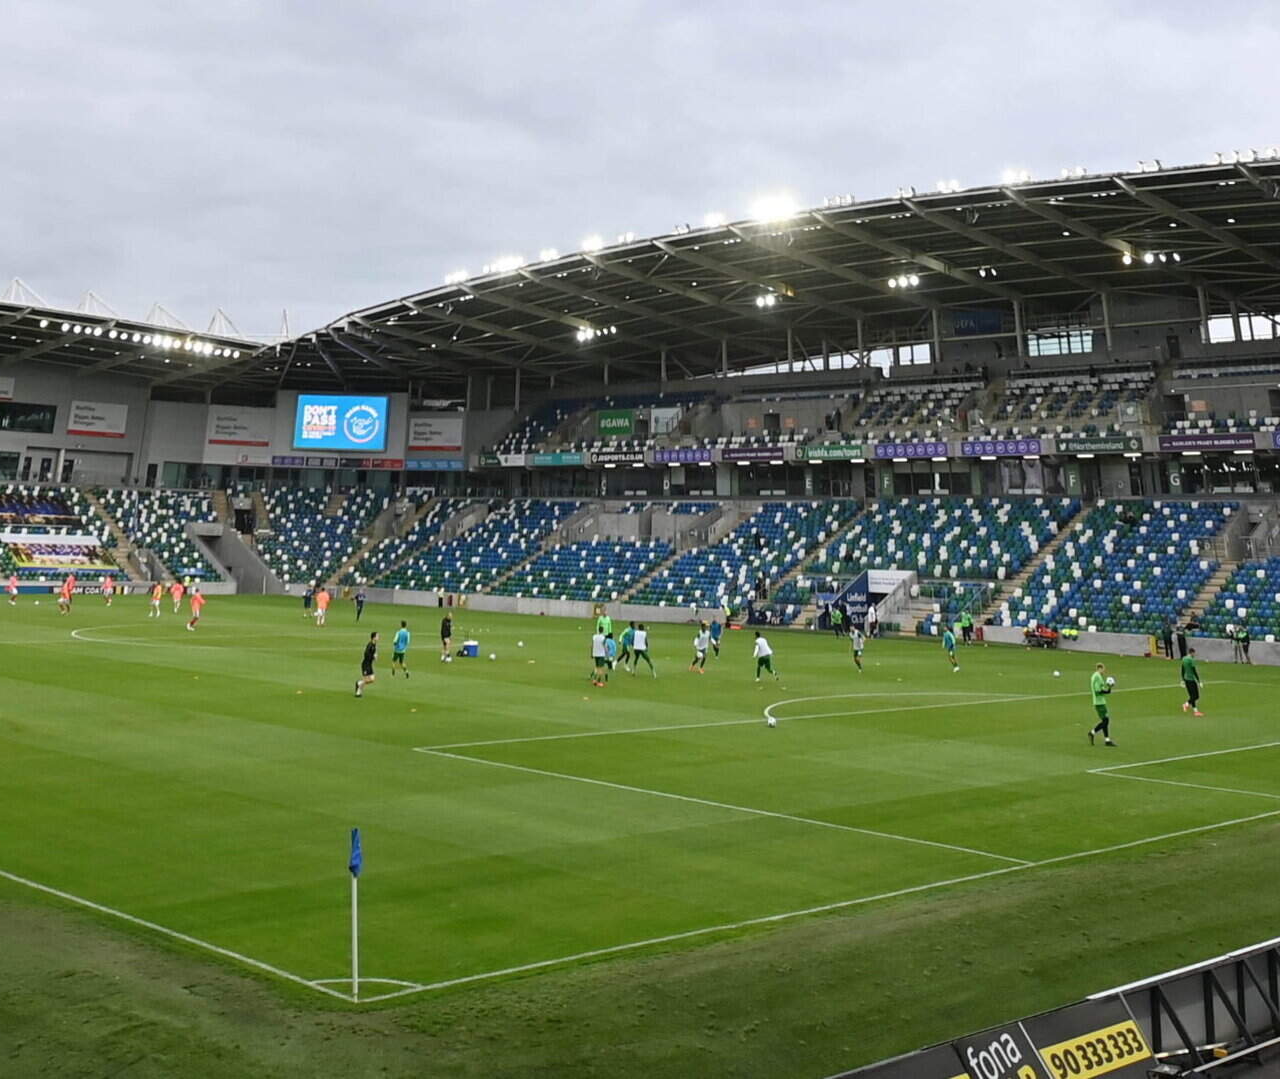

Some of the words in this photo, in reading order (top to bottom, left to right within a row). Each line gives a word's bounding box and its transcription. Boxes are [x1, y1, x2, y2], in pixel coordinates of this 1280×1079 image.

[304, 416, 336, 426] PASS
[600, 419, 630, 428] #GAWA
[1069, 441, 1124, 451] @NorthernIreland
[663, 479, 670, 489] D
[806, 478, 813, 489] E
[884, 477, 890, 488] F
[1070, 474, 1077, 486] F
[1170, 473, 1180, 486] G
[846, 591, 867, 602] Linfield
[966, 1032, 1023, 1079] fona
